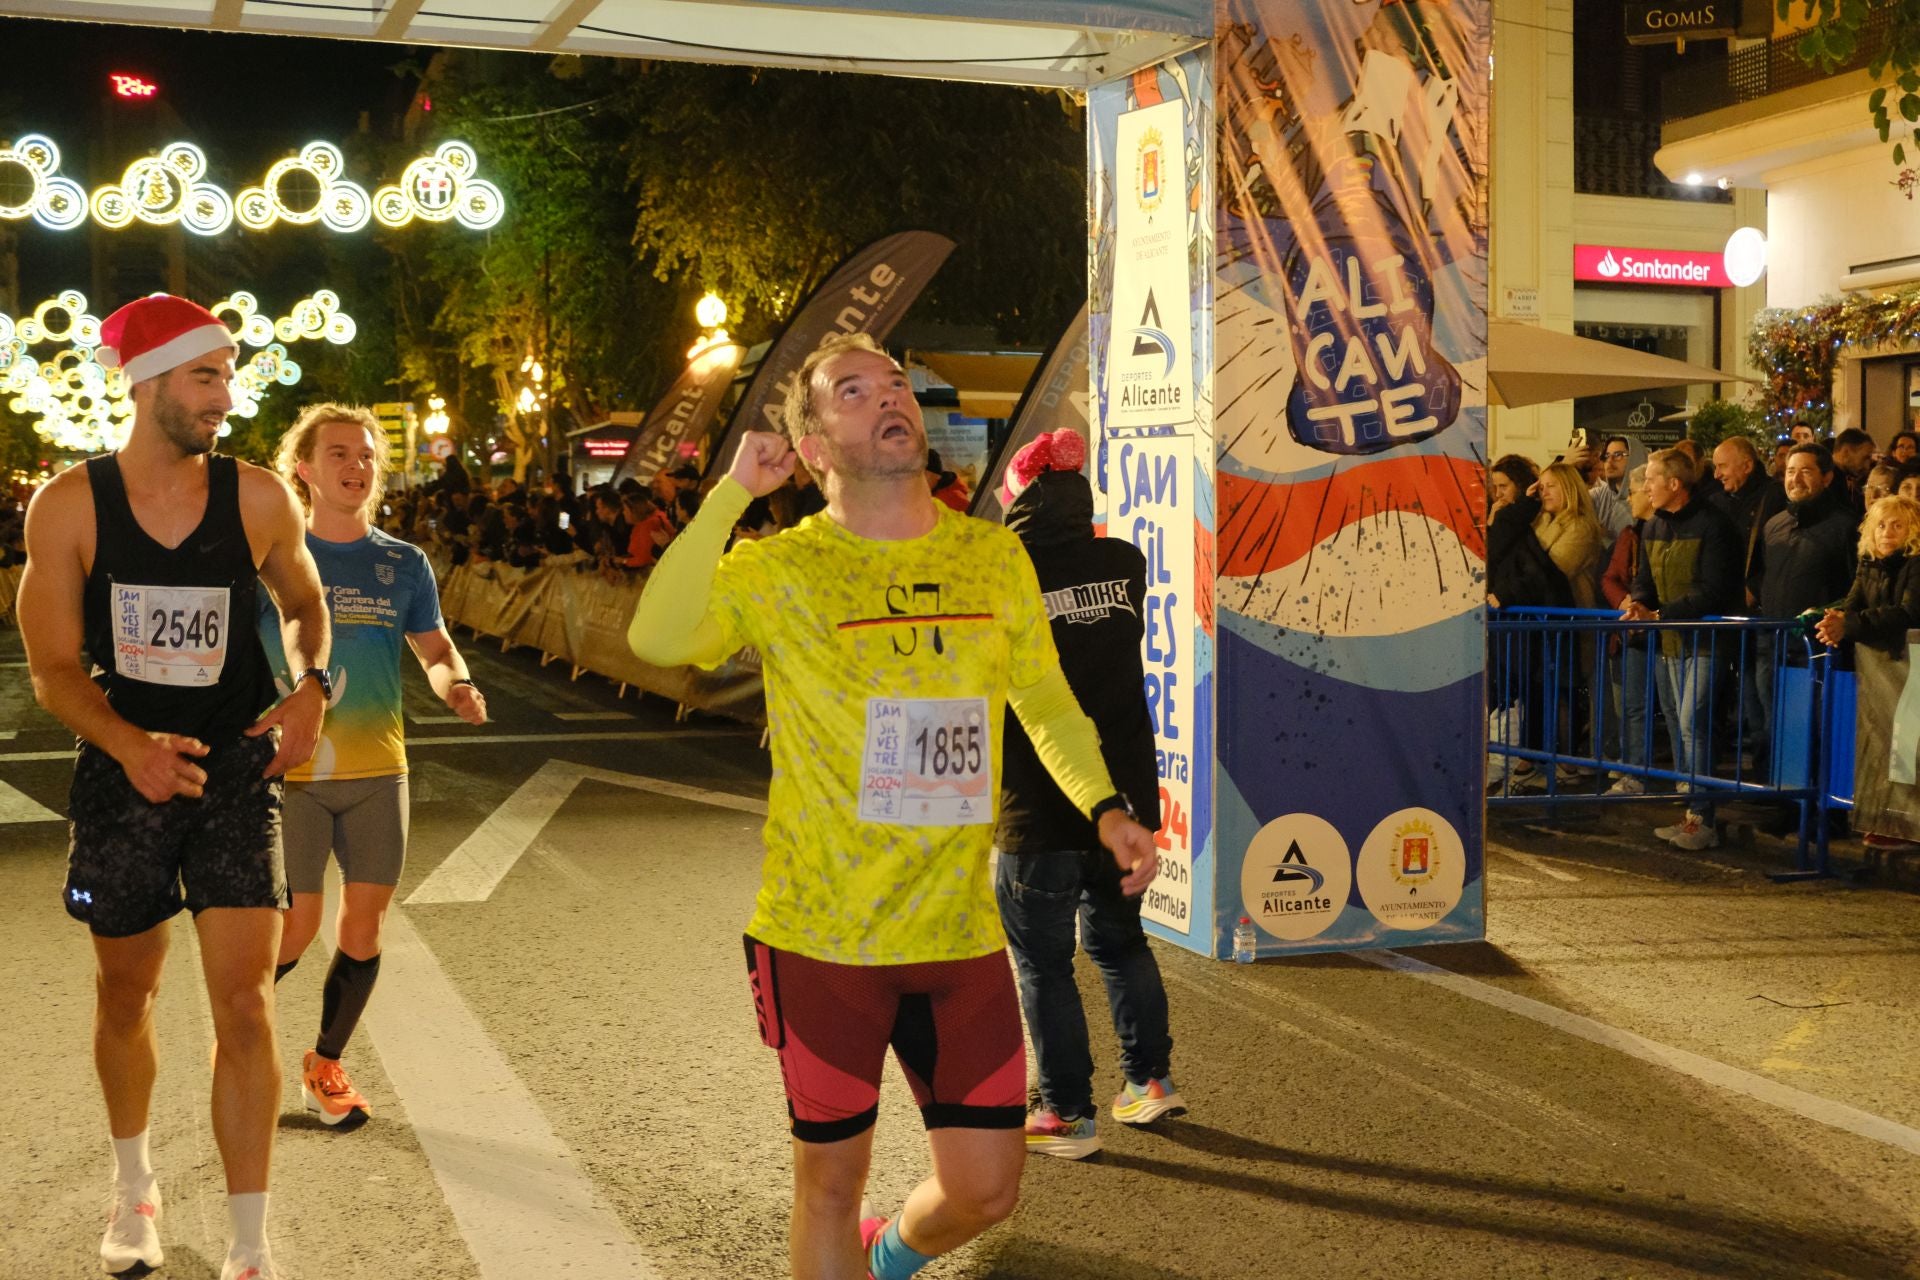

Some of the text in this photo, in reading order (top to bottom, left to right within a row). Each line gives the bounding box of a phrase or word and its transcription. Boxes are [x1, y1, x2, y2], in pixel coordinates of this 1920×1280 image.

[1622, 256, 1711, 281] Santander
[1297, 253, 1416, 320] ALI
[1304, 325, 1426, 392] CAN
[1121, 383, 1181, 407] Alicante
[1306, 383, 1439, 447] TE
[1119, 443, 1177, 518] SAN
[118, 588, 140, 602] SAN
[333, 585, 360, 596] Gran
[333, 594, 391, 607] Carrera del
[121, 614, 140, 627] VES
[1070, 608, 1105, 621] SPEAKER
[121, 626, 140, 638] TRE
[150, 608, 220, 649] 2546
[1146, 592, 1177, 669] ES
[118, 643, 145, 656] 2024
[875, 702, 901, 719] SAN
[1144, 671, 1179, 740] RE
[877, 735, 900, 750] VES
[915, 725, 982, 776] 1855
[874, 751, 899, 766] TRE
[1155, 749, 1188, 785] aria
[866, 775, 901, 790] 2024
[1153, 786, 1188, 851] 24
[1262, 889, 1297, 899] DEPORTES
[1148, 888, 1187, 920] Rambla
[1263, 896, 1331, 914] Alicante
[1380, 900, 1447, 912] AYUNTAMIENTO
